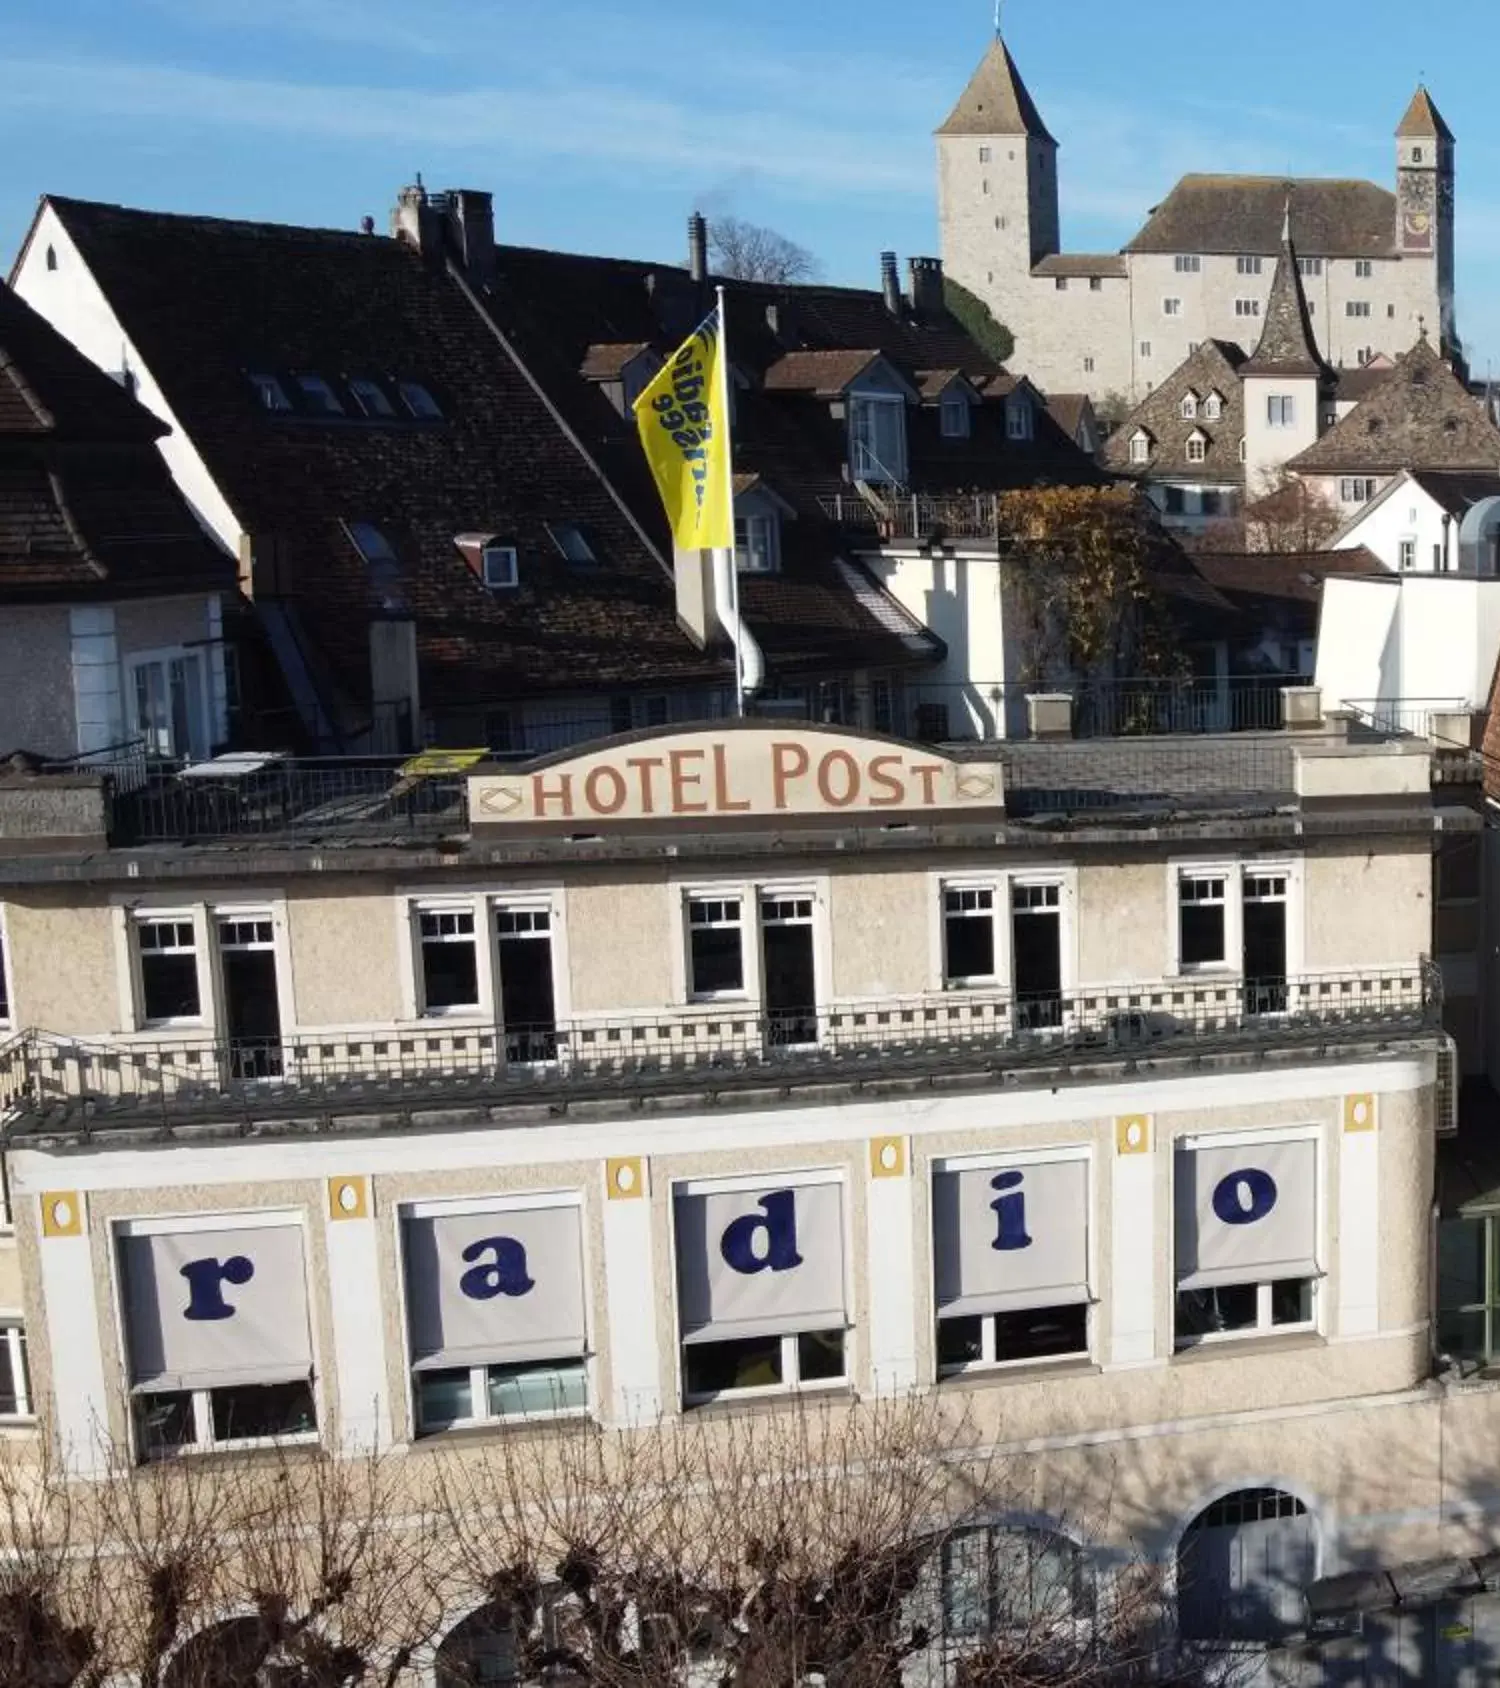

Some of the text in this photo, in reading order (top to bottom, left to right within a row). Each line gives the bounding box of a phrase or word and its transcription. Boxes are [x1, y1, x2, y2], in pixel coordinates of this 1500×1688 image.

[532, 741, 943, 817] HOTEL POST
[180, 1166, 1277, 1321] radio
